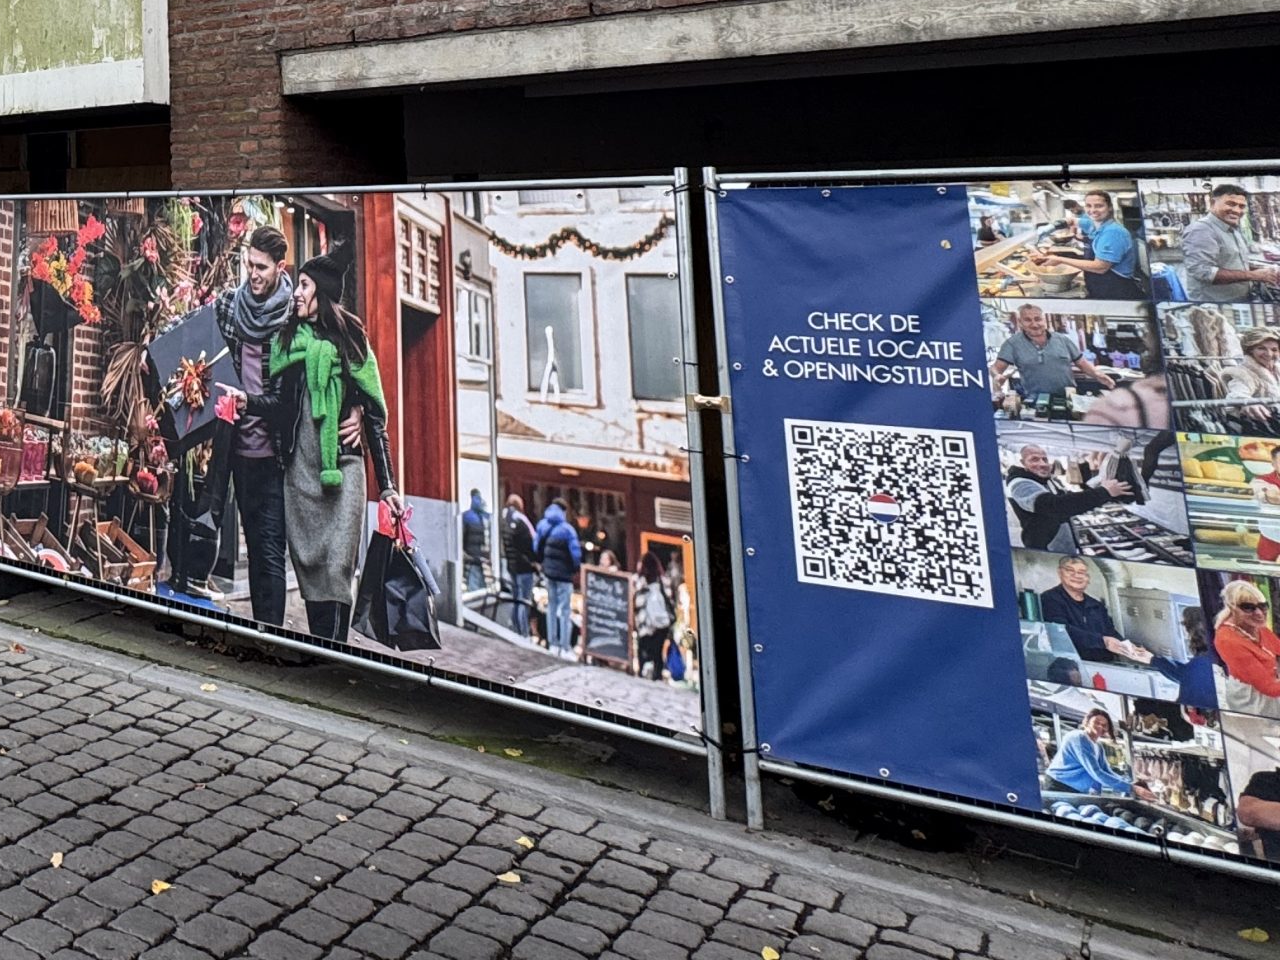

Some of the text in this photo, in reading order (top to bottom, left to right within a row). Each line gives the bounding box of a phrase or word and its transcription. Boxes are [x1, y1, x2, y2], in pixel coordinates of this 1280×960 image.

[808, 311, 921, 333] CHECK DE
[768, 334, 964, 361] ACTUELE LOCATIE
[762, 358, 985, 389] & OPENINGSTIJDEN
